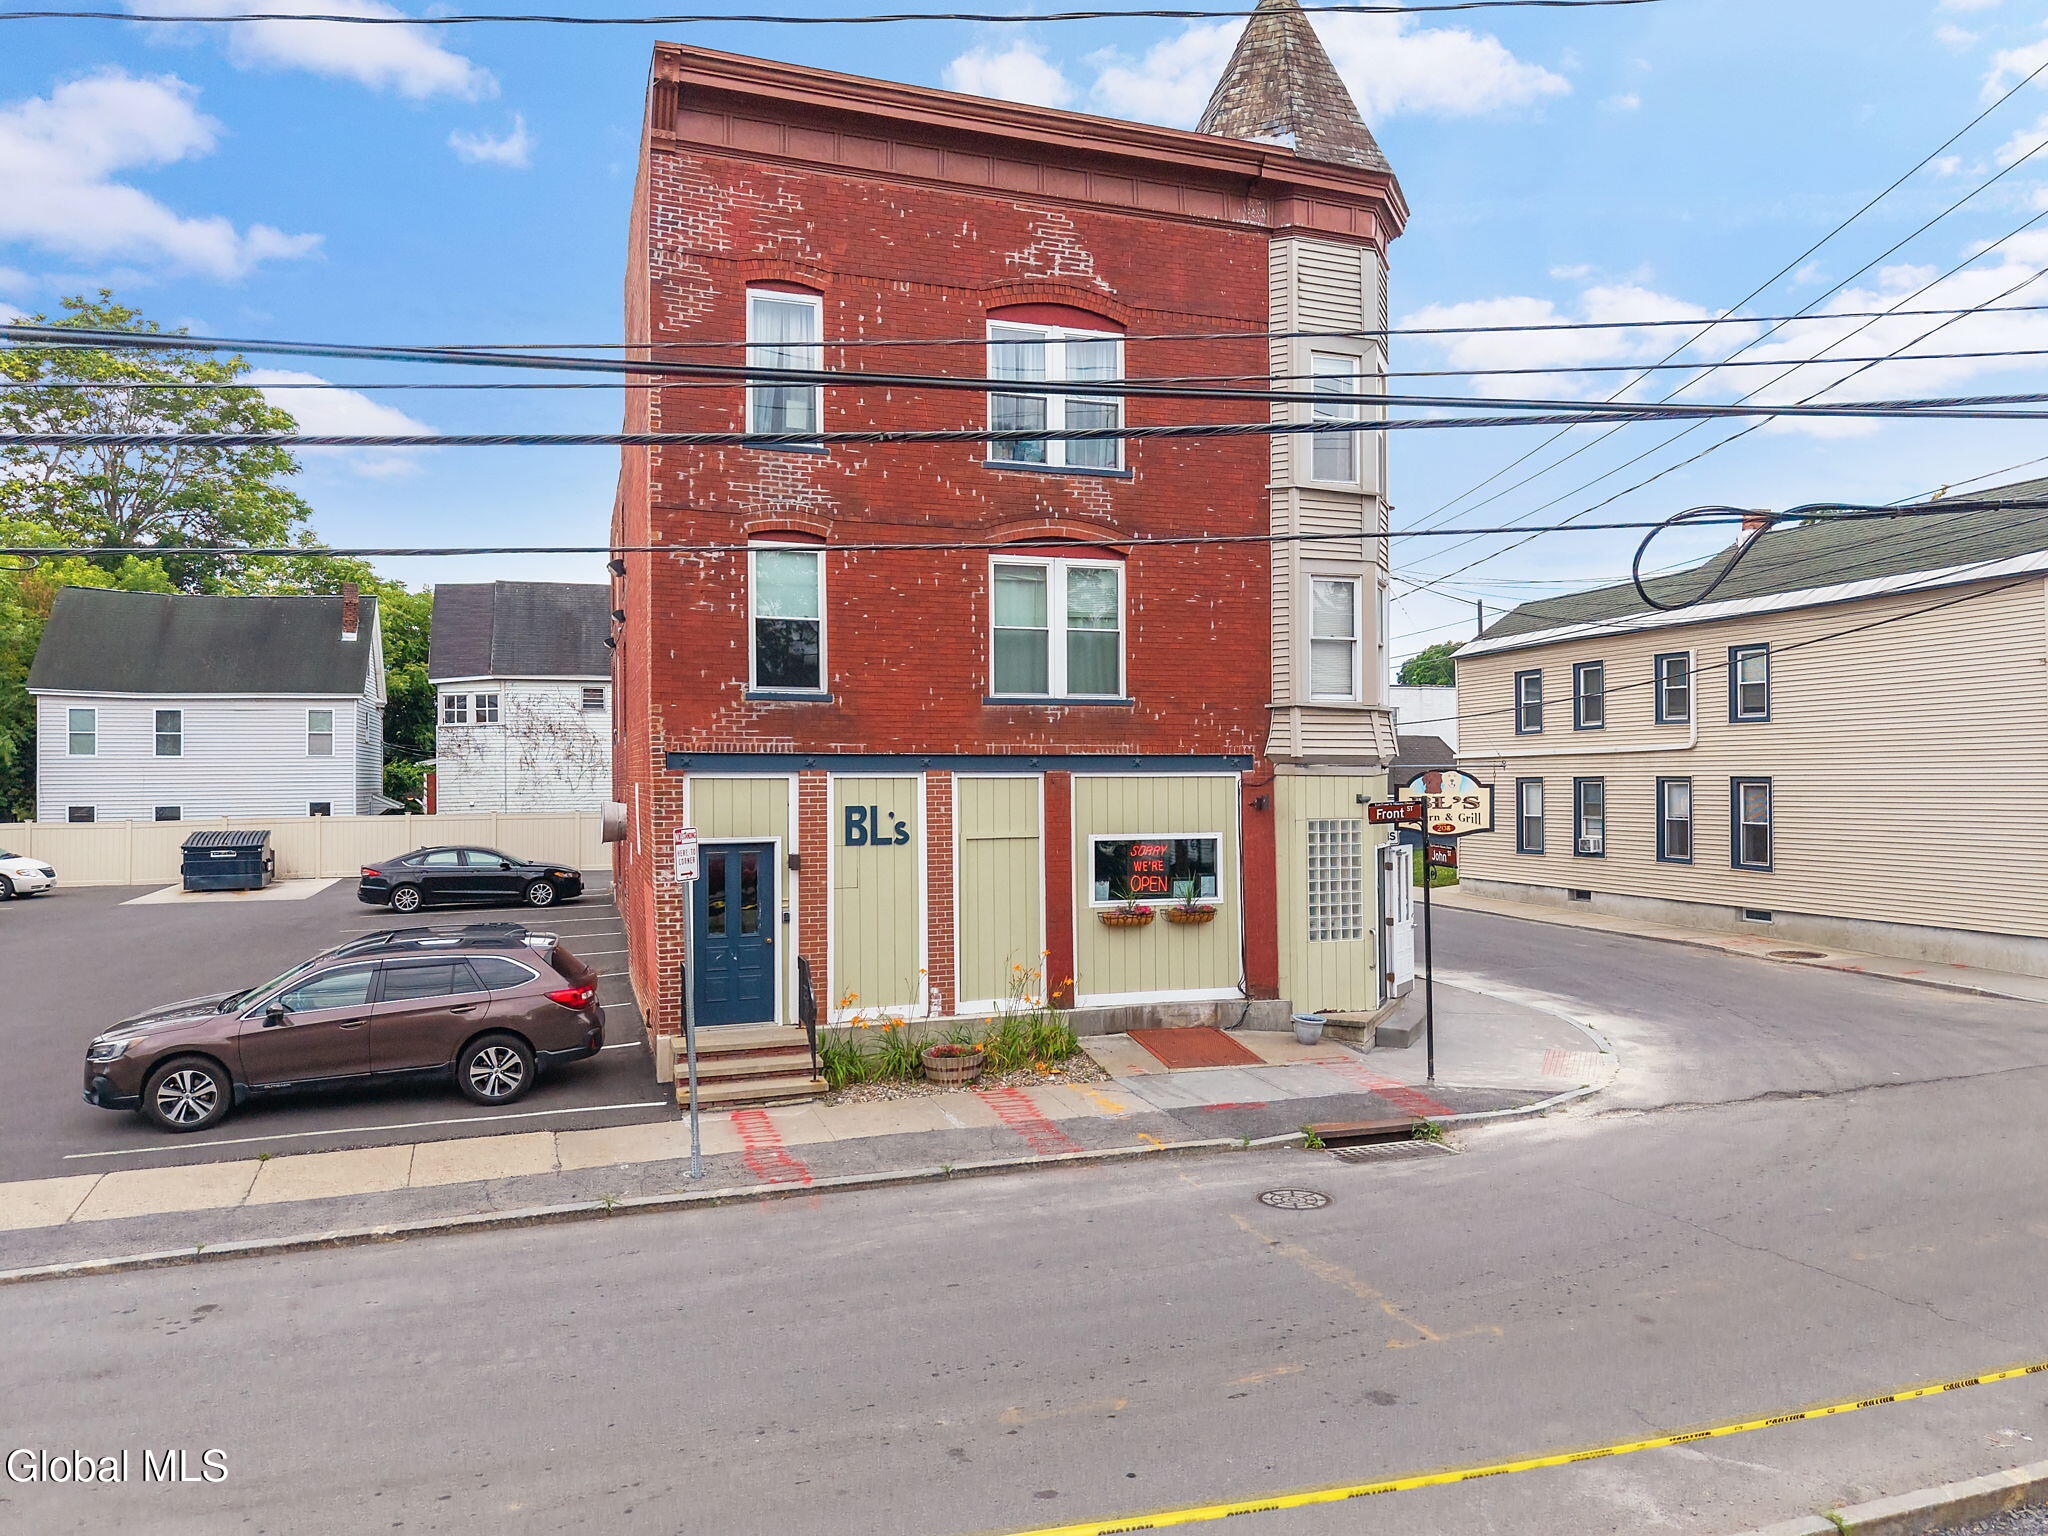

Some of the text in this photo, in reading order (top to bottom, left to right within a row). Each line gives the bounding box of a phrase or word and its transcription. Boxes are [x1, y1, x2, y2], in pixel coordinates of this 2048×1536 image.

[1376, 808, 1405, 819] Front
[1445, 812, 1453, 821] &
[1458, 812, 1481, 825] Grill
[845, 805, 910, 846] BL's
[1130, 845, 1168, 857] SORRY
[1431, 849, 1447, 863] John
[1133, 860, 1165, 872] WE'RE
[1130, 874, 1168, 892] OPEN
